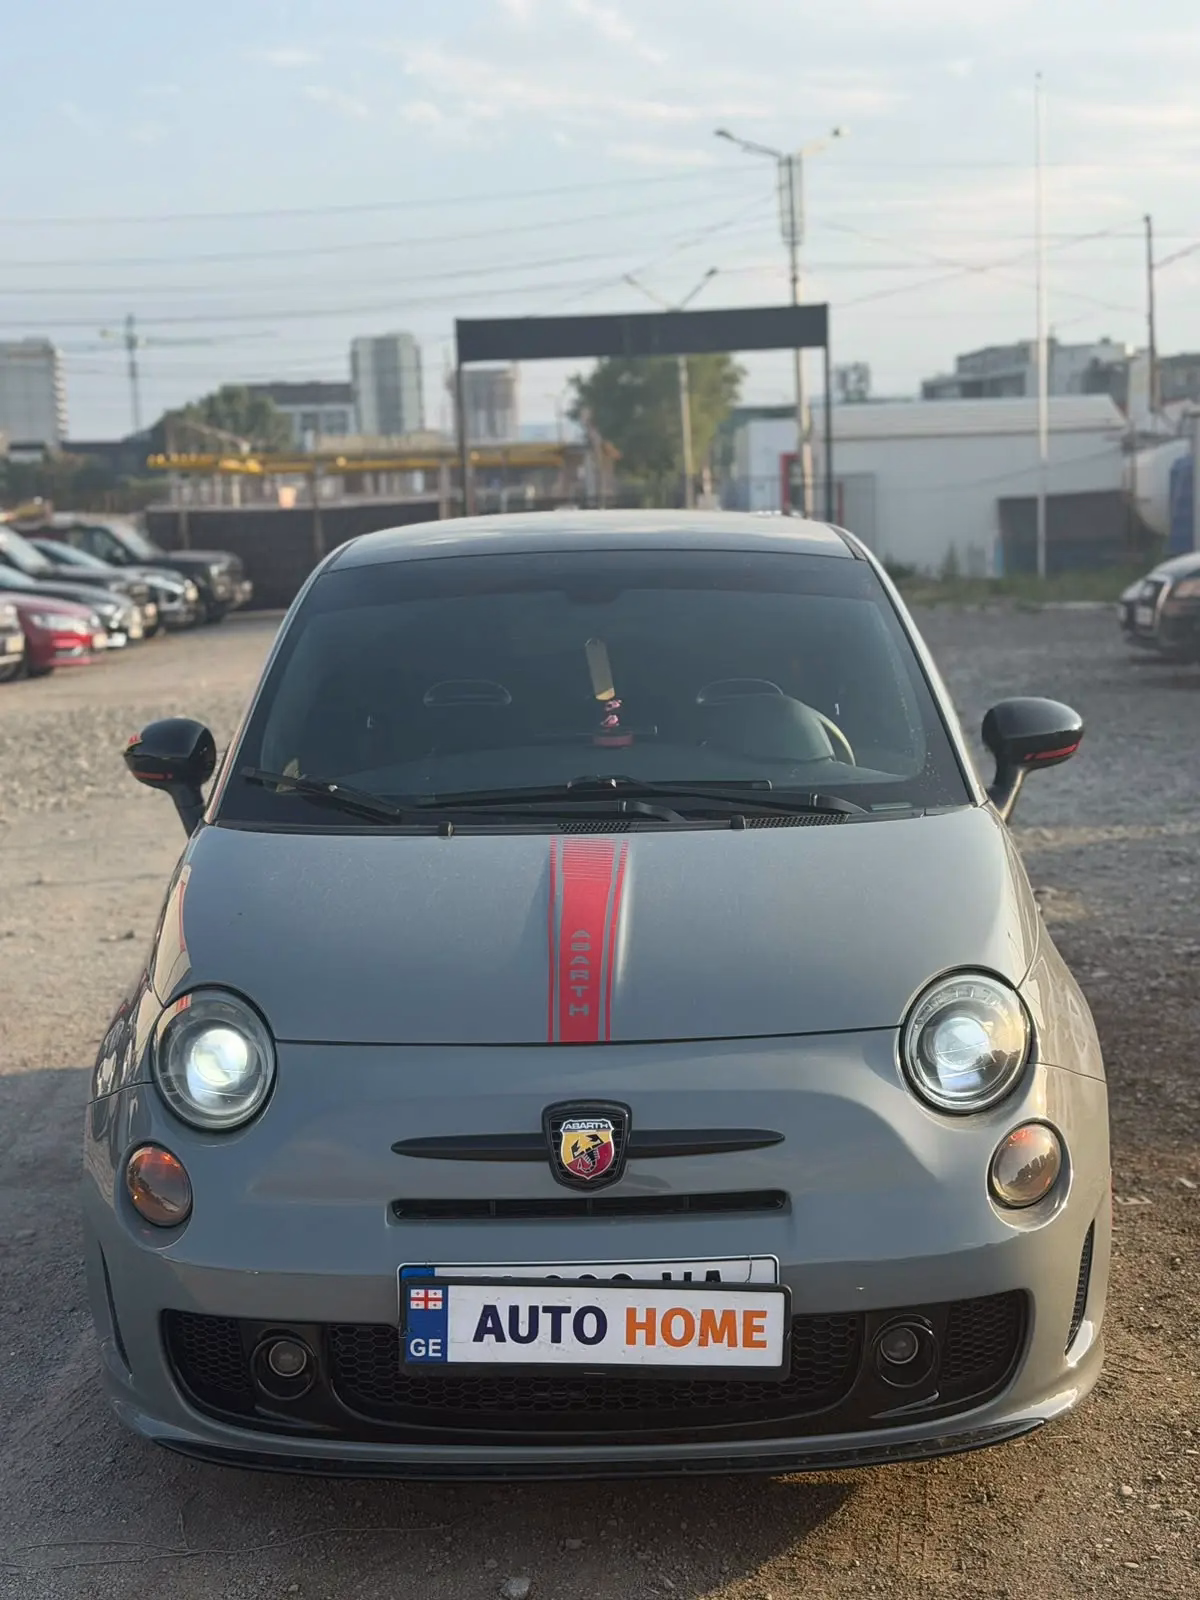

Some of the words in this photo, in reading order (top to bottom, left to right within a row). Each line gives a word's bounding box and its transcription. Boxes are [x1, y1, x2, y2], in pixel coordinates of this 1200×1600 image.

[569, 929, 591, 1017] ABARTH
[564, 1122, 609, 1130] ABARTH
[472, 1304, 608, 1346] AUTO
[625, 1307, 768, 1348] HOME
[409, 1338, 442, 1357] GE
